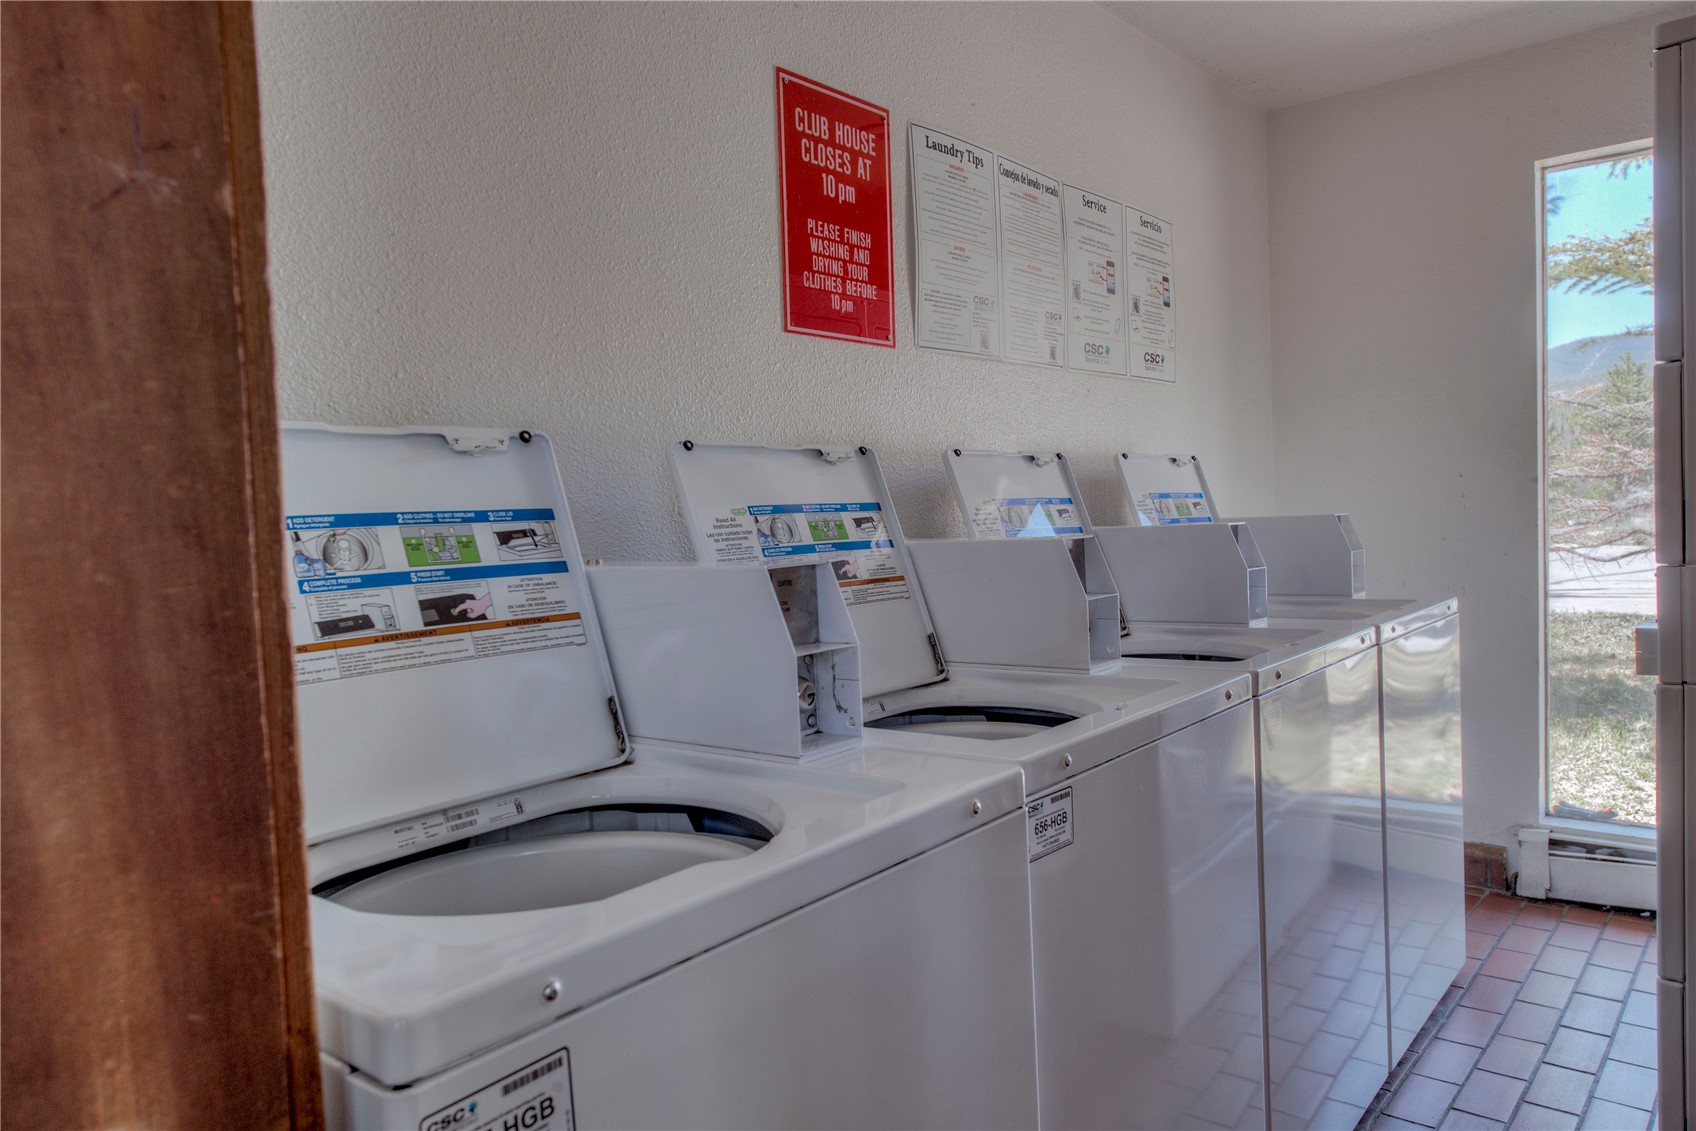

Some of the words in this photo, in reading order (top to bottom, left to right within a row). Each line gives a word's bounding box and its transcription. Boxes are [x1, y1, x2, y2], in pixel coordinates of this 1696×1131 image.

[795, 107, 829, 140] CLUB
[835, 121, 876, 156] HOUSE
[801, 138, 851, 175] CLOSES
[857, 157, 872, 181] AT
[925, 135, 964, 163] Laundry
[966, 149, 984, 169] Tips
[822, 173, 836, 198] 10
[838, 182, 855, 204] pm
[999, 163, 1020, 183] Consejos
[1021, 171, 1026, 185] de
[1026, 173, 1041, 191] lavado
[1044, 185, 1059, 198] secado
[1081, 194, 1107, 214] Service
[807, 218, 840, 242] PLEASE
[844, 227, 871, 249] FINISH
[1139, 215, 1162, 234] Servicio
[809, 236, 850, 261] WASHING
[853, 247, 870, 265] AND
[812, 255, 843, 277] DRYING
[847, 262, 869, 282] YOUR
[803, 271, 842, 294] CLOTHES
[846, 279, 877, 300] BEFORE
[831, 294, 840, 310] 10
[841, 299, 854, 314] pm
[973, 295, 990, 306] CSC
[1045, 310, 1059, 321] CSC
[1084, 342, 1104, 356] CSC
[1144, 352, 1160, 364] CSC
[287, 518, 293, 528] 1
[397, 513, 404, 523] 2
[488, 512, 494, 520] 3
[303, 581, 309, 592] 4
[411, 572, 417, 582] 5
[511, 616, 550, 626] ADVERTENCIA
[381, 630, 437, 642] AVERTISSEMENT
[1027, 803, 1040, 814] CSC
[1034, 811, 1067, 835] 656-HGB
[427, 1108, 465, 1131] CSC
